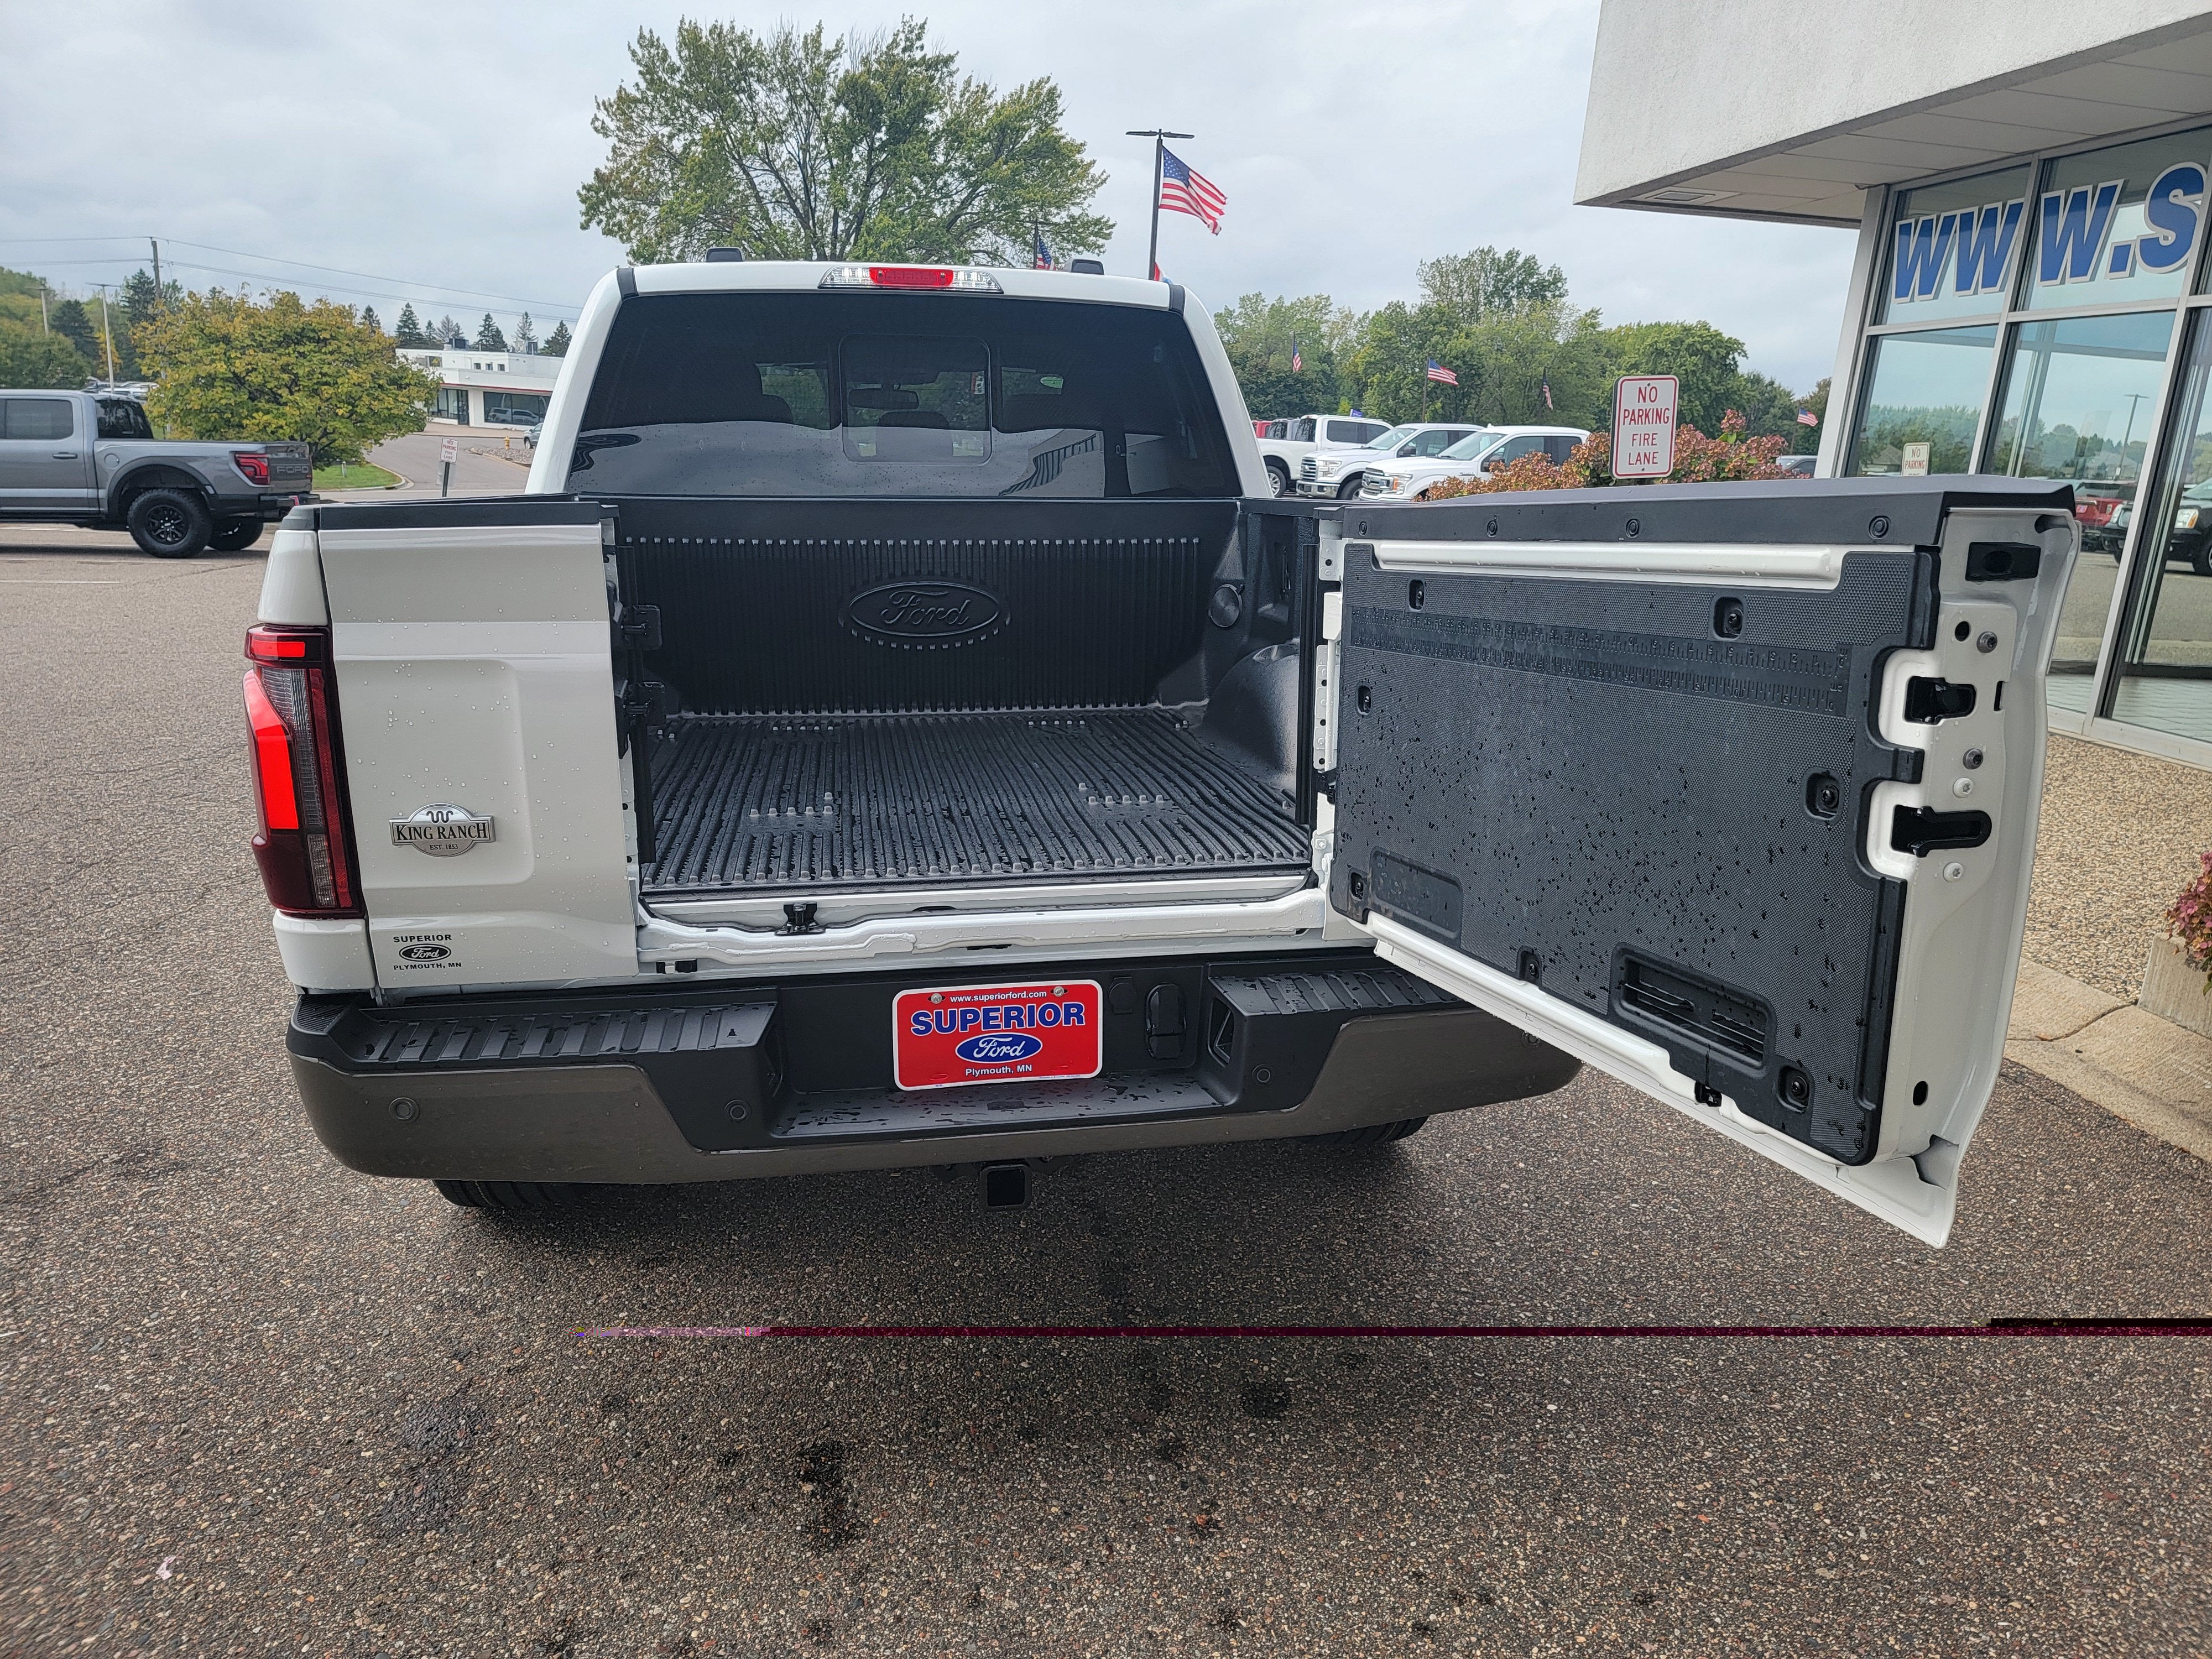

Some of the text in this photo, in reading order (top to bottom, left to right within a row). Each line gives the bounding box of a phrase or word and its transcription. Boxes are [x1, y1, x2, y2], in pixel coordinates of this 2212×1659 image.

[1637, 386, 1658, 404] NO
[1623, 407, 1670, 426] PARKING
[1631, 432, 1658, 447] FIRE
[1628, 451, 1659, 466] LANE
[1911, 448, 1921, 458] NO
[276, 466, 309, 474] FORD
[1905, 460, 1925, 469] PARKING
[880, 589, 972, 625] Ford
[1671, 641, 1676, 650] 8
[1688, 643, 1694, 652] 7
[1728, 647, 1734, 656] 5
[1770, 651, 1776, 661] 3
[1792, 653, 1798, 663] 2
[1695, 682, 1705, 693] 15
[1733, 687, 1745, 698] 10
[1783, 695, 1789, 705] 5
[1828, 702, 1834, 712] 0
[395, 822, 488, 841] KING RANCH
[393, 934, 452, 943] SUPERIOR
[411, 947, 441, 959] Ford
[950, 990, 1047, 1004] www.superiorford.com
[910, 1002, 1085, 1036] SUPERIOR
[973, 1036, 1026, 1059] Ford
[965, 1064, 1032, 1078] Plymouth, MN
